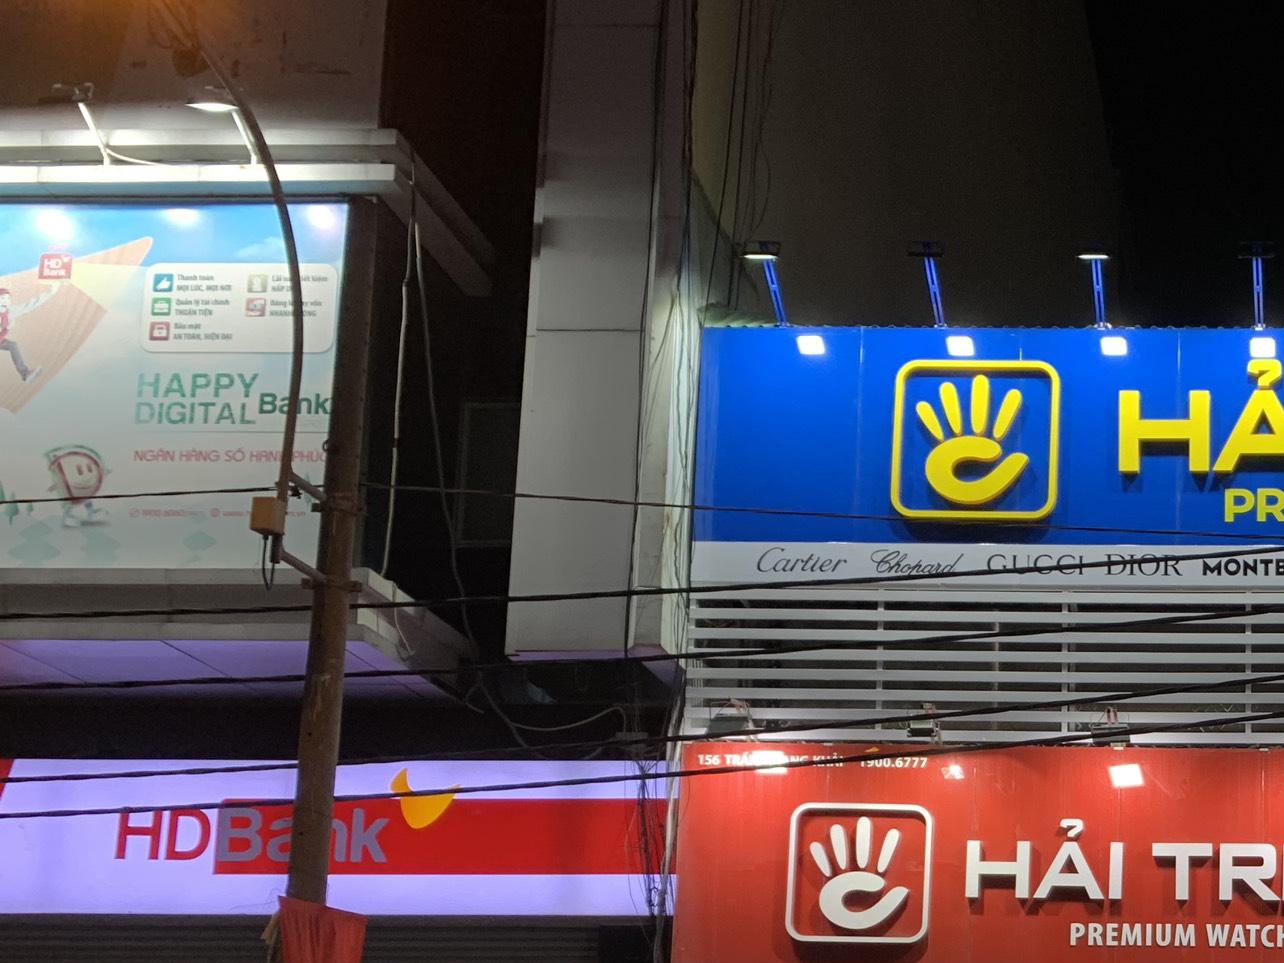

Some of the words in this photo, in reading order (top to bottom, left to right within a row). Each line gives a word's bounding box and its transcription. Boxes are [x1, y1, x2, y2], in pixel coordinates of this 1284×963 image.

[137, 373, 259, 398] HAPPY
[134, 401, 257, 425] DIGITAL
[756, 546, 848, 574] Cartier
[870, 549, 965, 576] Chopard
[986, 553, 1084, 576] GUCCI
[1104, 553, 1184, 577] DIOR
[698, 754, 720, 765] 156
[965, 818, 1124, 900] HẢI
[1070, 922, 1196, 947] PREMIUM
